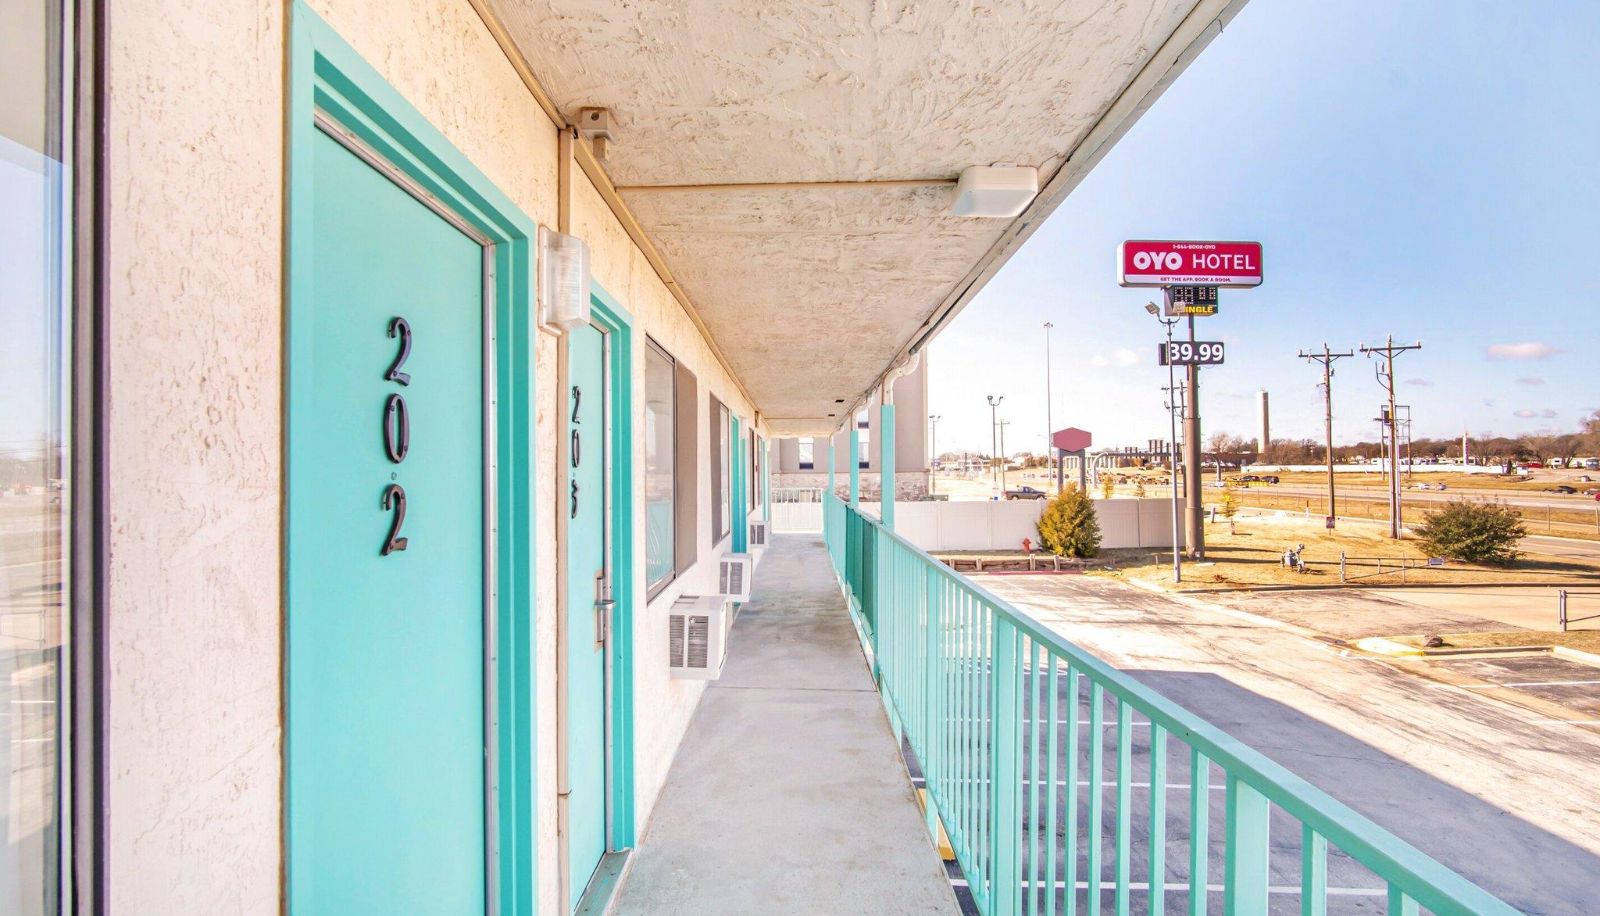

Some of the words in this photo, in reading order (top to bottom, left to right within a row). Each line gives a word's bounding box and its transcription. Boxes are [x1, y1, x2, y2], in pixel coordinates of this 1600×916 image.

[1133, 251, 1183, 270] OYO
[1192, 253, 1255, 270] HOTEL
[1170, 343, 1223, 361] 39.99
[379, 316, 412, 556] 202
